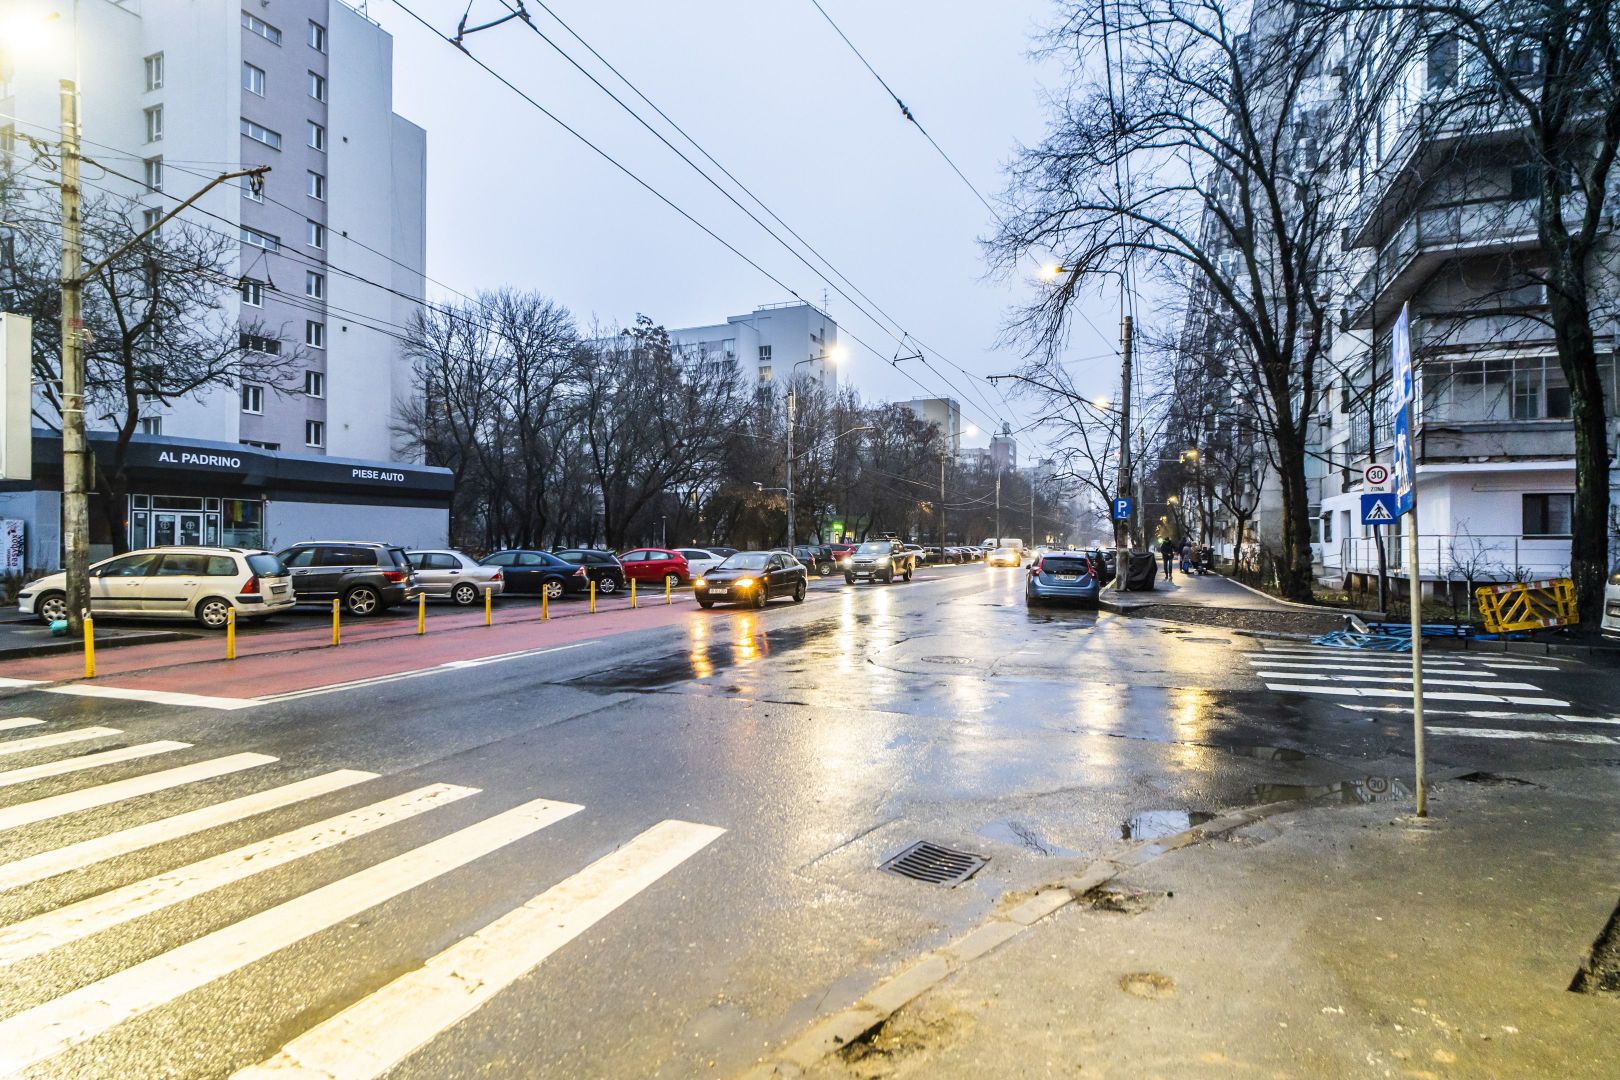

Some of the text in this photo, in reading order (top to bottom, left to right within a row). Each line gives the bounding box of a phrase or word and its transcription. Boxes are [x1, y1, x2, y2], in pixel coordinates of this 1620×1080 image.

[158, 451, 241, 468] AL PADRINO
[352, 469, 404, 482] PIESE AUTO
[1371, 470, 1383, 480] 30
[1117, 500, 1128, 513] P
[10, 534, 18, 567] easybox
